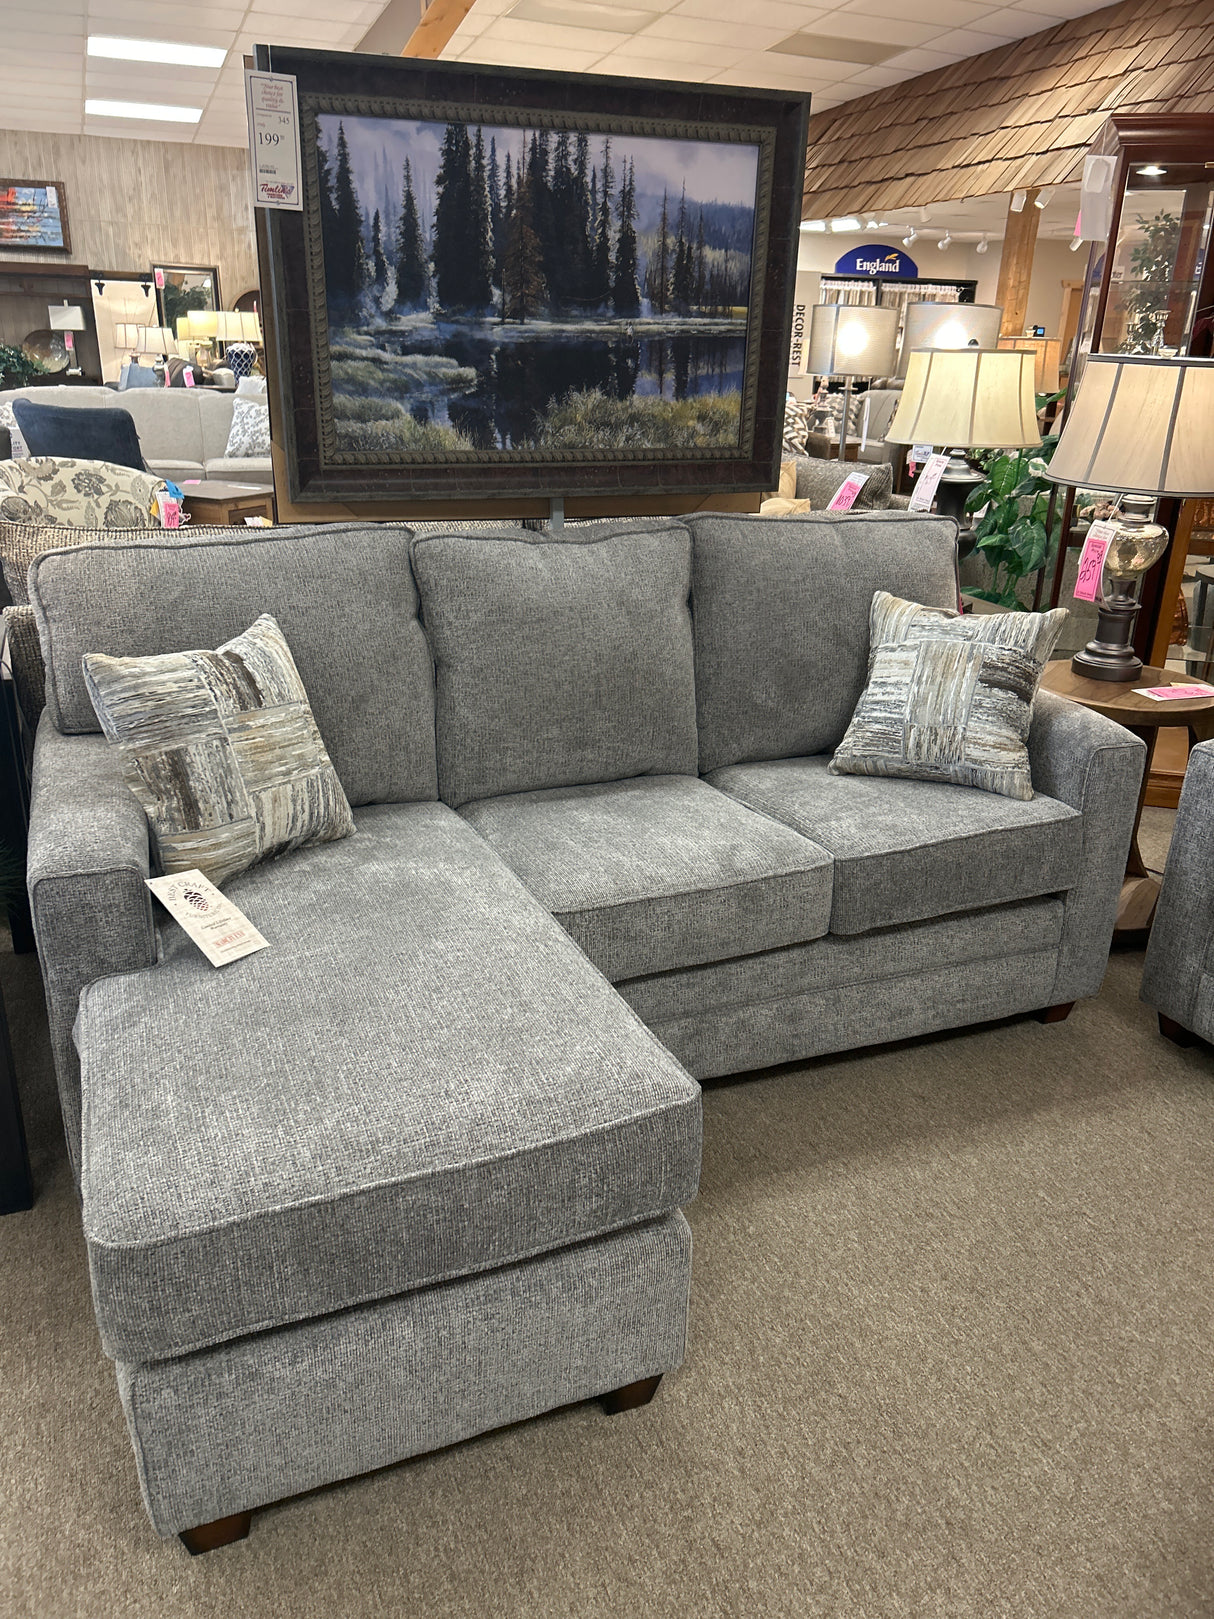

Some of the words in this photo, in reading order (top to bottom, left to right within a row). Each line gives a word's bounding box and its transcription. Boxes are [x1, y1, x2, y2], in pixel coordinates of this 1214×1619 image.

[259, 131, 280, 146] 199
[855, 258, 900, 275] England
[791, 304, 806, 367] DECOR-REST
